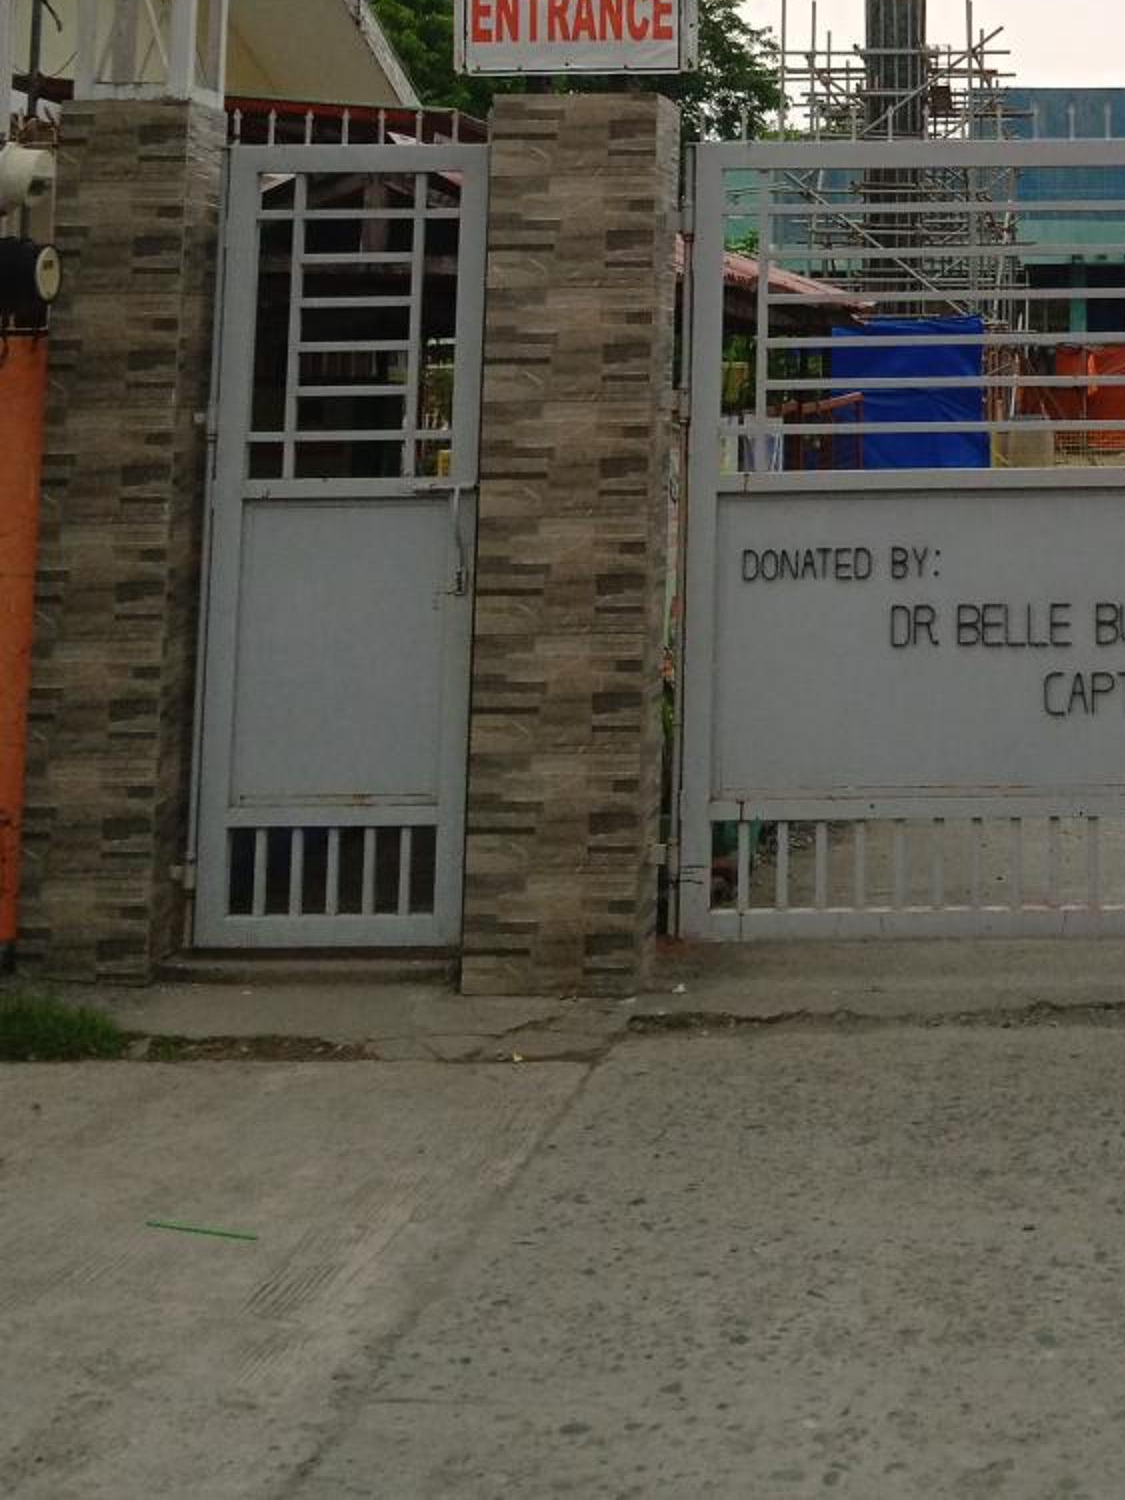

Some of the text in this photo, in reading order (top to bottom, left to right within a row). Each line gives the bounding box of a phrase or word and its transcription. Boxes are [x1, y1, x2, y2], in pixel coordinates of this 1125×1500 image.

[742, 547, 942, 583] DONATED BY:
[957, 603, 1073, 647] BELLE
